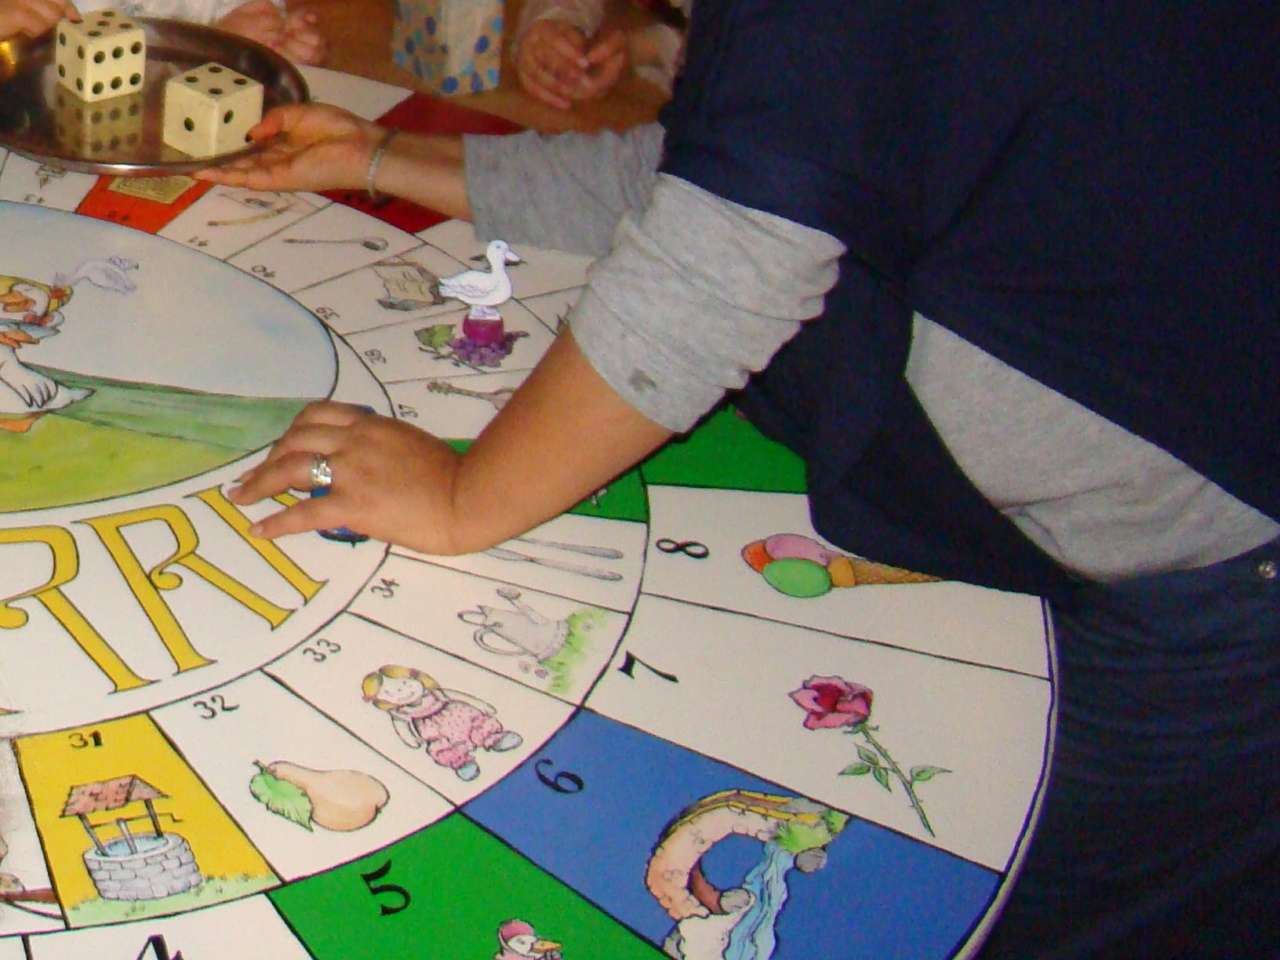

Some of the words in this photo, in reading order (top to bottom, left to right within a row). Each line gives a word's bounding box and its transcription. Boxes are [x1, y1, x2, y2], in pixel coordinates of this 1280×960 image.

[655, 537, 710, 560] 8
[370, 576, 401, 599] 34
[302, 637, 342, 663] 33
[617, 648, 680, 683] 7
[191, 693, 241, 721] 32
[68, 729, 104, 750] 31
[534, 757, 586, 794] 6
[360, 858, 413, 917] 5
